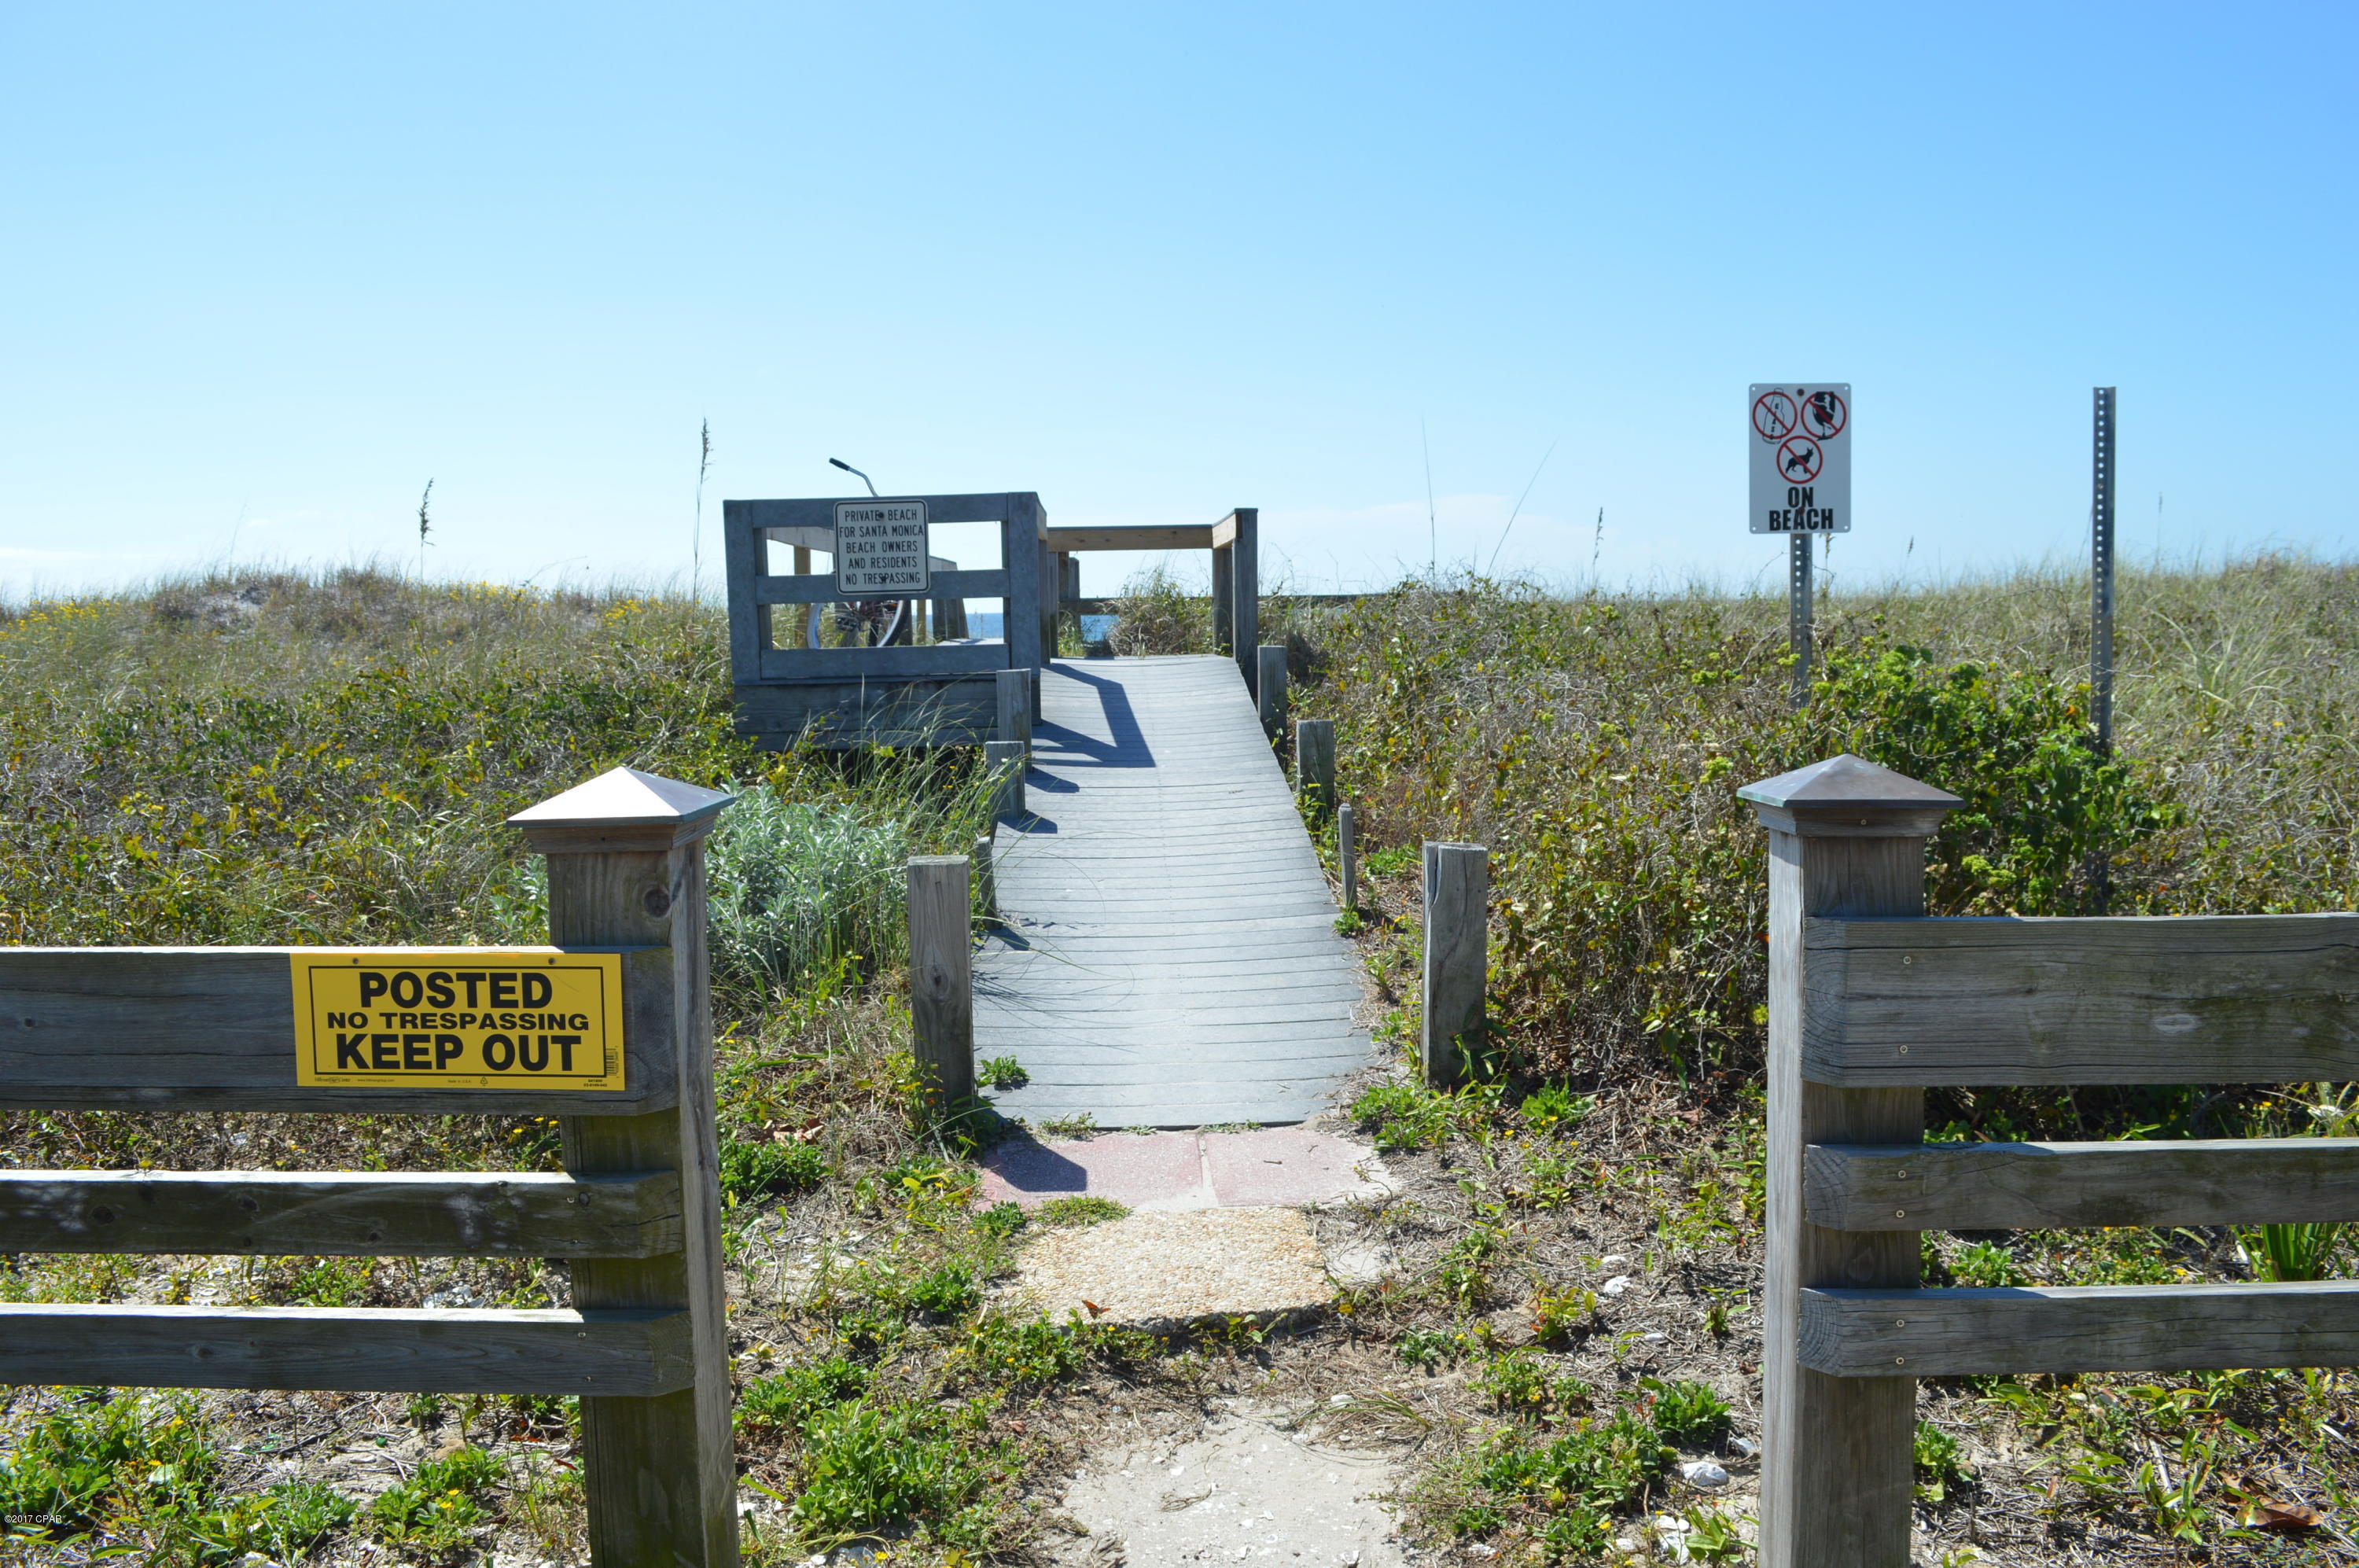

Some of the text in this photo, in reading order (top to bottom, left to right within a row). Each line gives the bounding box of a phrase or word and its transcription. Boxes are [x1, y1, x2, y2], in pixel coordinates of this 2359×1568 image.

[1787, 487, 1813, 508] ON
[845, 510, 917, 522] PRIVATE BEACH
[1769, 509, 1833, 532] BEACH
[839, 525, 924, 538] FOR SANTA MONICA
[846, 541, 918, 554] BEACH OWNERS
[848, 557, 918, 569] AND RESIDENTS
[845, 572, 920, 585] NO TRESPASSING
[359, 971, 553, 1009] POSTED
[327, 1012, 589, 1031] NO TRESPASSING
[336, 1033, 464, 1070] KEEP
[482, 1033, 582, 1072] OUT
